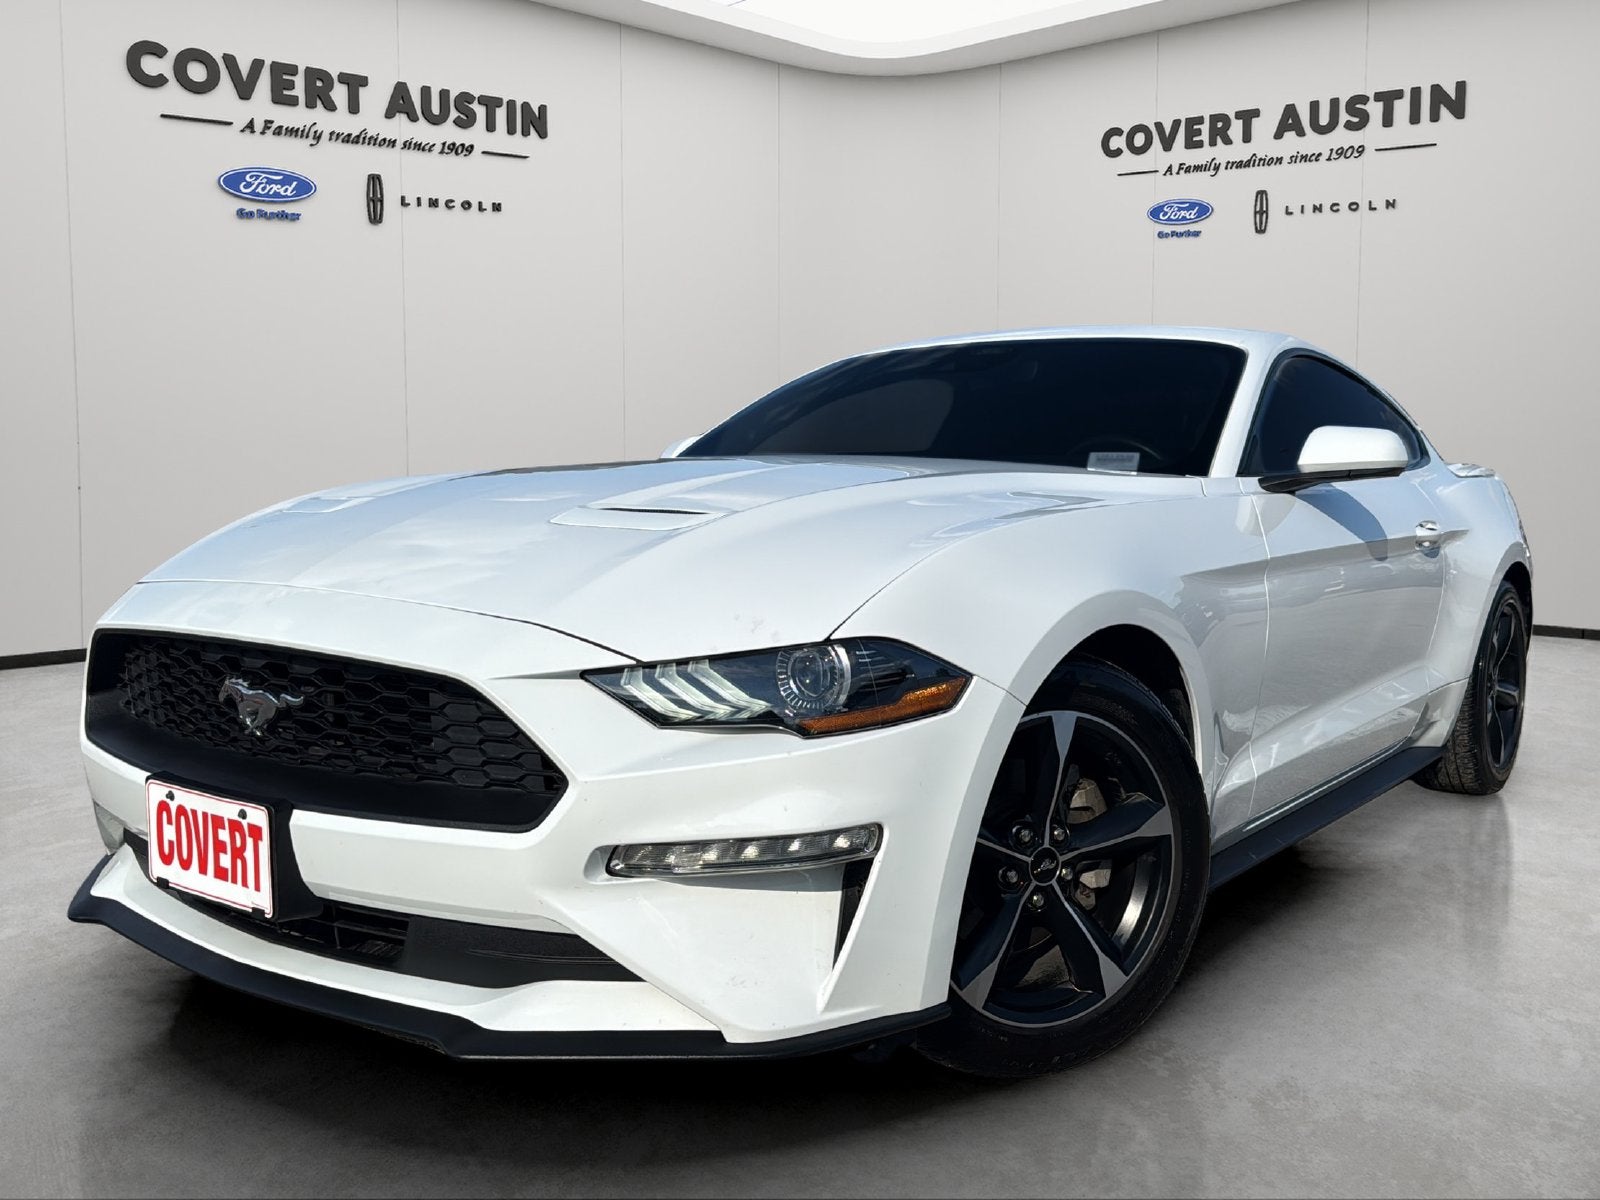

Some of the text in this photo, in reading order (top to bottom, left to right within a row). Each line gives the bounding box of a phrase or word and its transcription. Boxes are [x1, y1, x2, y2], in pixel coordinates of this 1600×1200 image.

[126, 40, 548, 139] COVERT AUSTIN
[1101, 80, 1467, 158] COVERT AUSTIN
[240, 117, 475, 157] A Family tradition since 1909
[1163, 145, 1366, 177] A Family tradition since 1909
[239, 172, 298, 196] Ford
[400, 195, 502, 212] LINCOLN
[1159, 203, 1199, 220] Ford
[1285, 199, 1397, 216] LINCOLN
[156, 800, 263, 892] COVERT
